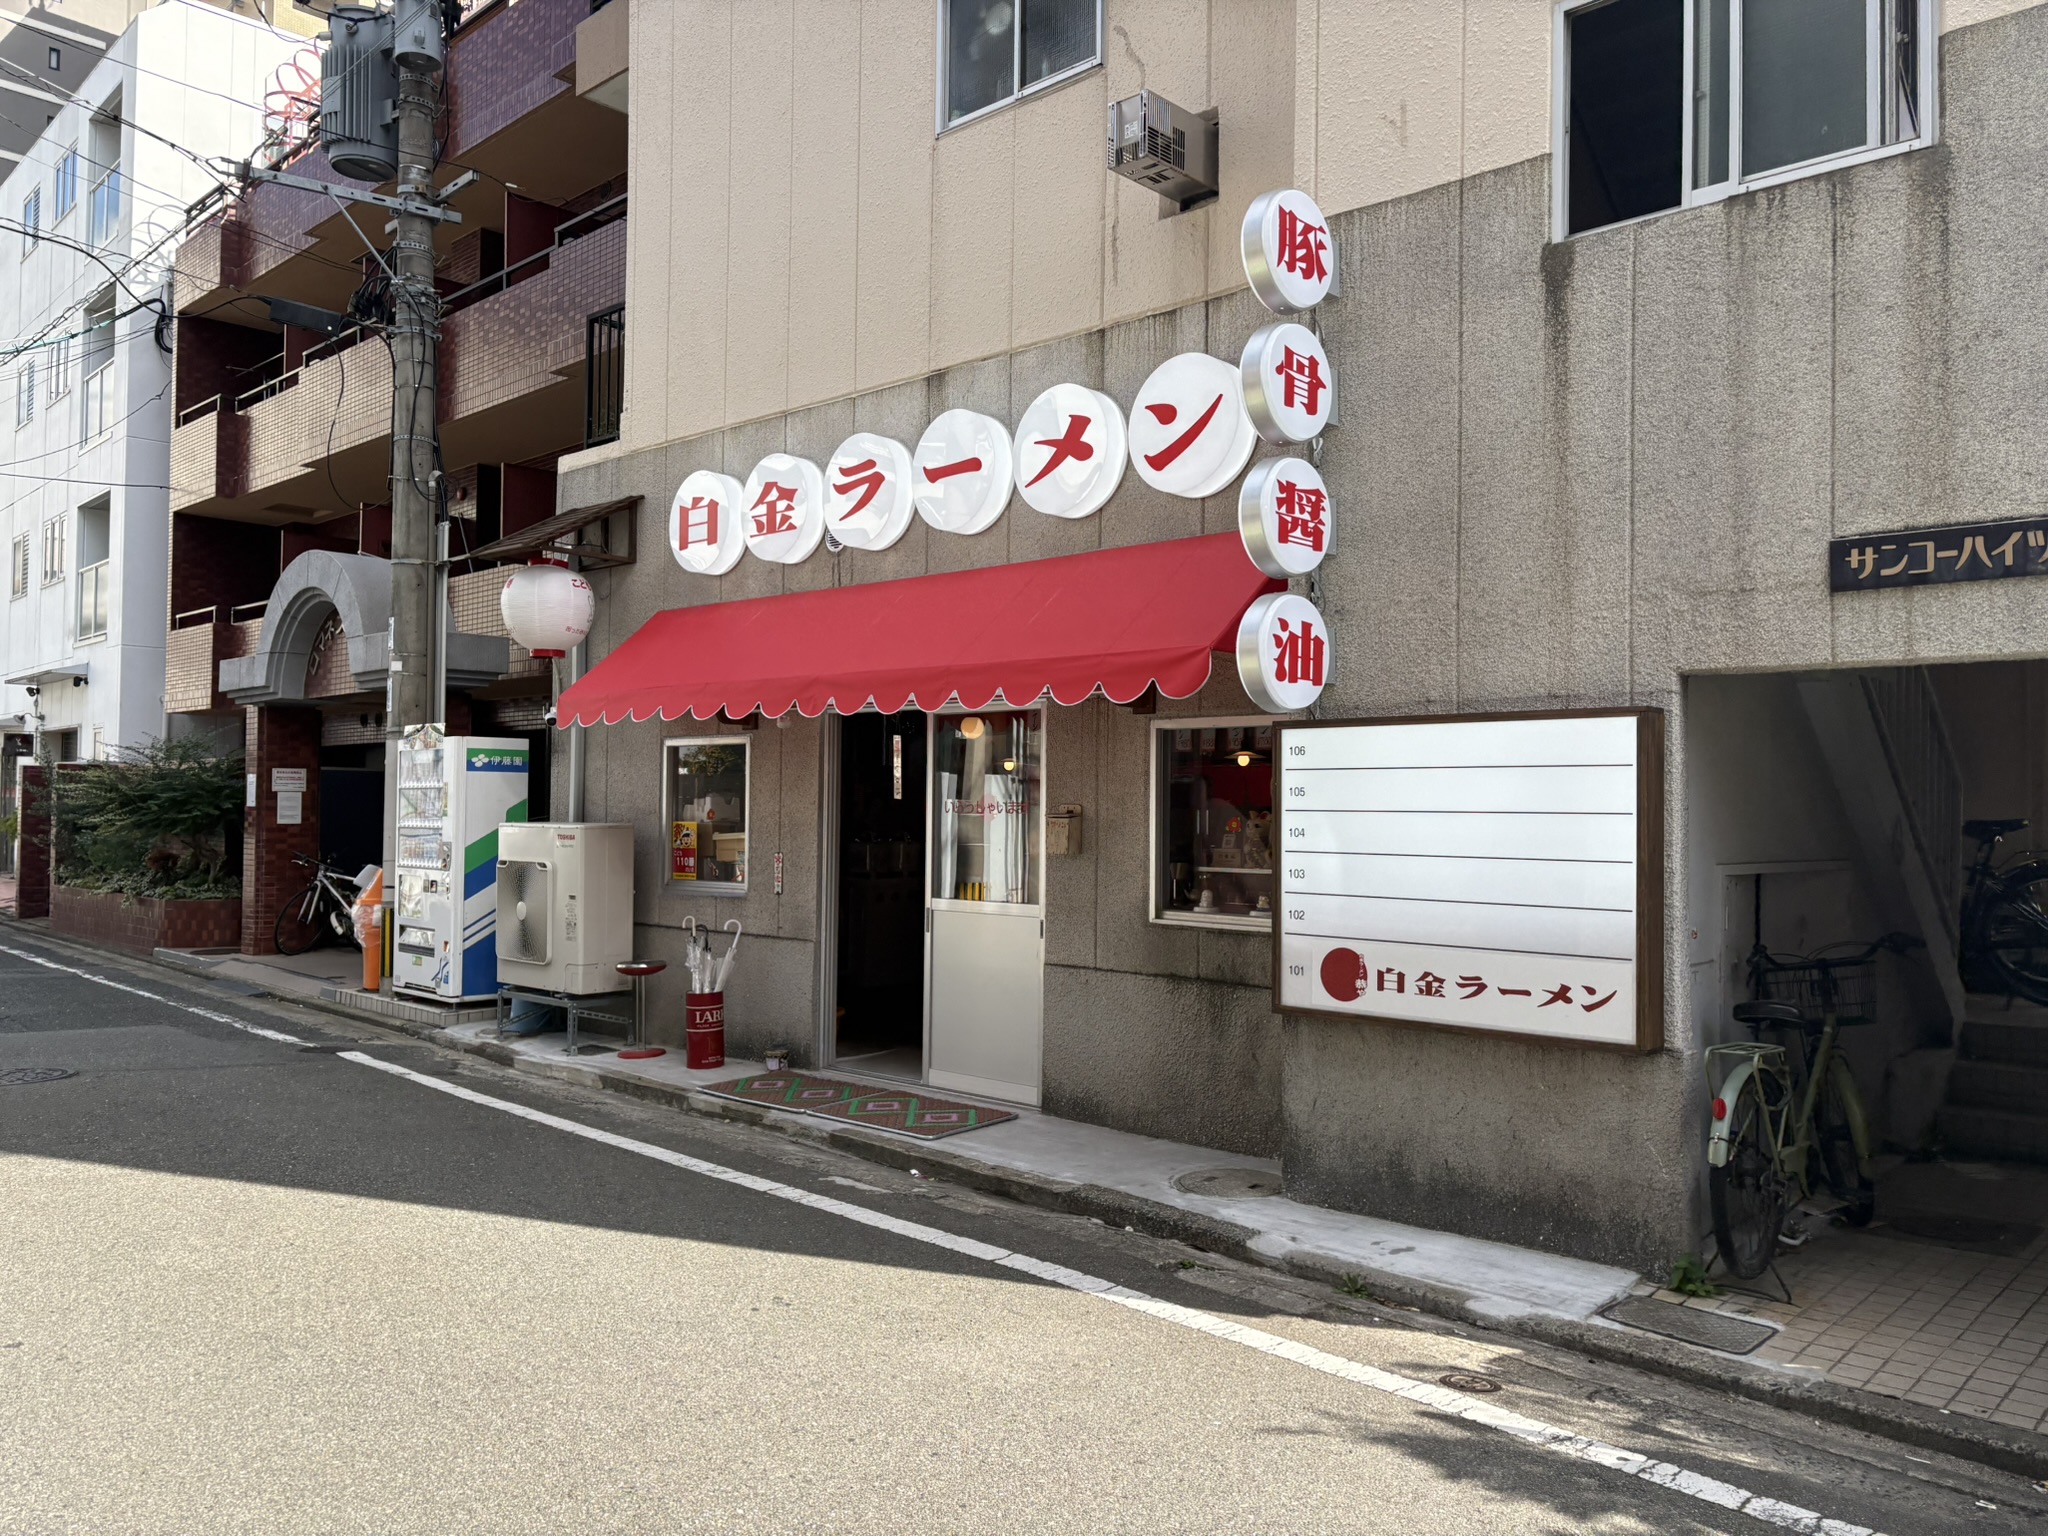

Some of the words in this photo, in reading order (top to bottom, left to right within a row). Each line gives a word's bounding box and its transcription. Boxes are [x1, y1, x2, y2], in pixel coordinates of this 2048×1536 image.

[1274, 203, 1329, 687] 豚骨醤油
[678, 392, 1224, 552] 白金ラーメン
[1288, 746, 1306, 756] 106
[490, 755, 523, 766] 伊藤園
[1288, 787, 1306, 797] 105
[1288, 828, 1306, 838] 104
[1288, 869, 1306, 879] 103
[1288, 910, 1305, 921] 102
[1288, 965, 1305, 976] 101
[1376, 966, 1618, 1013] 白金ラーメン
